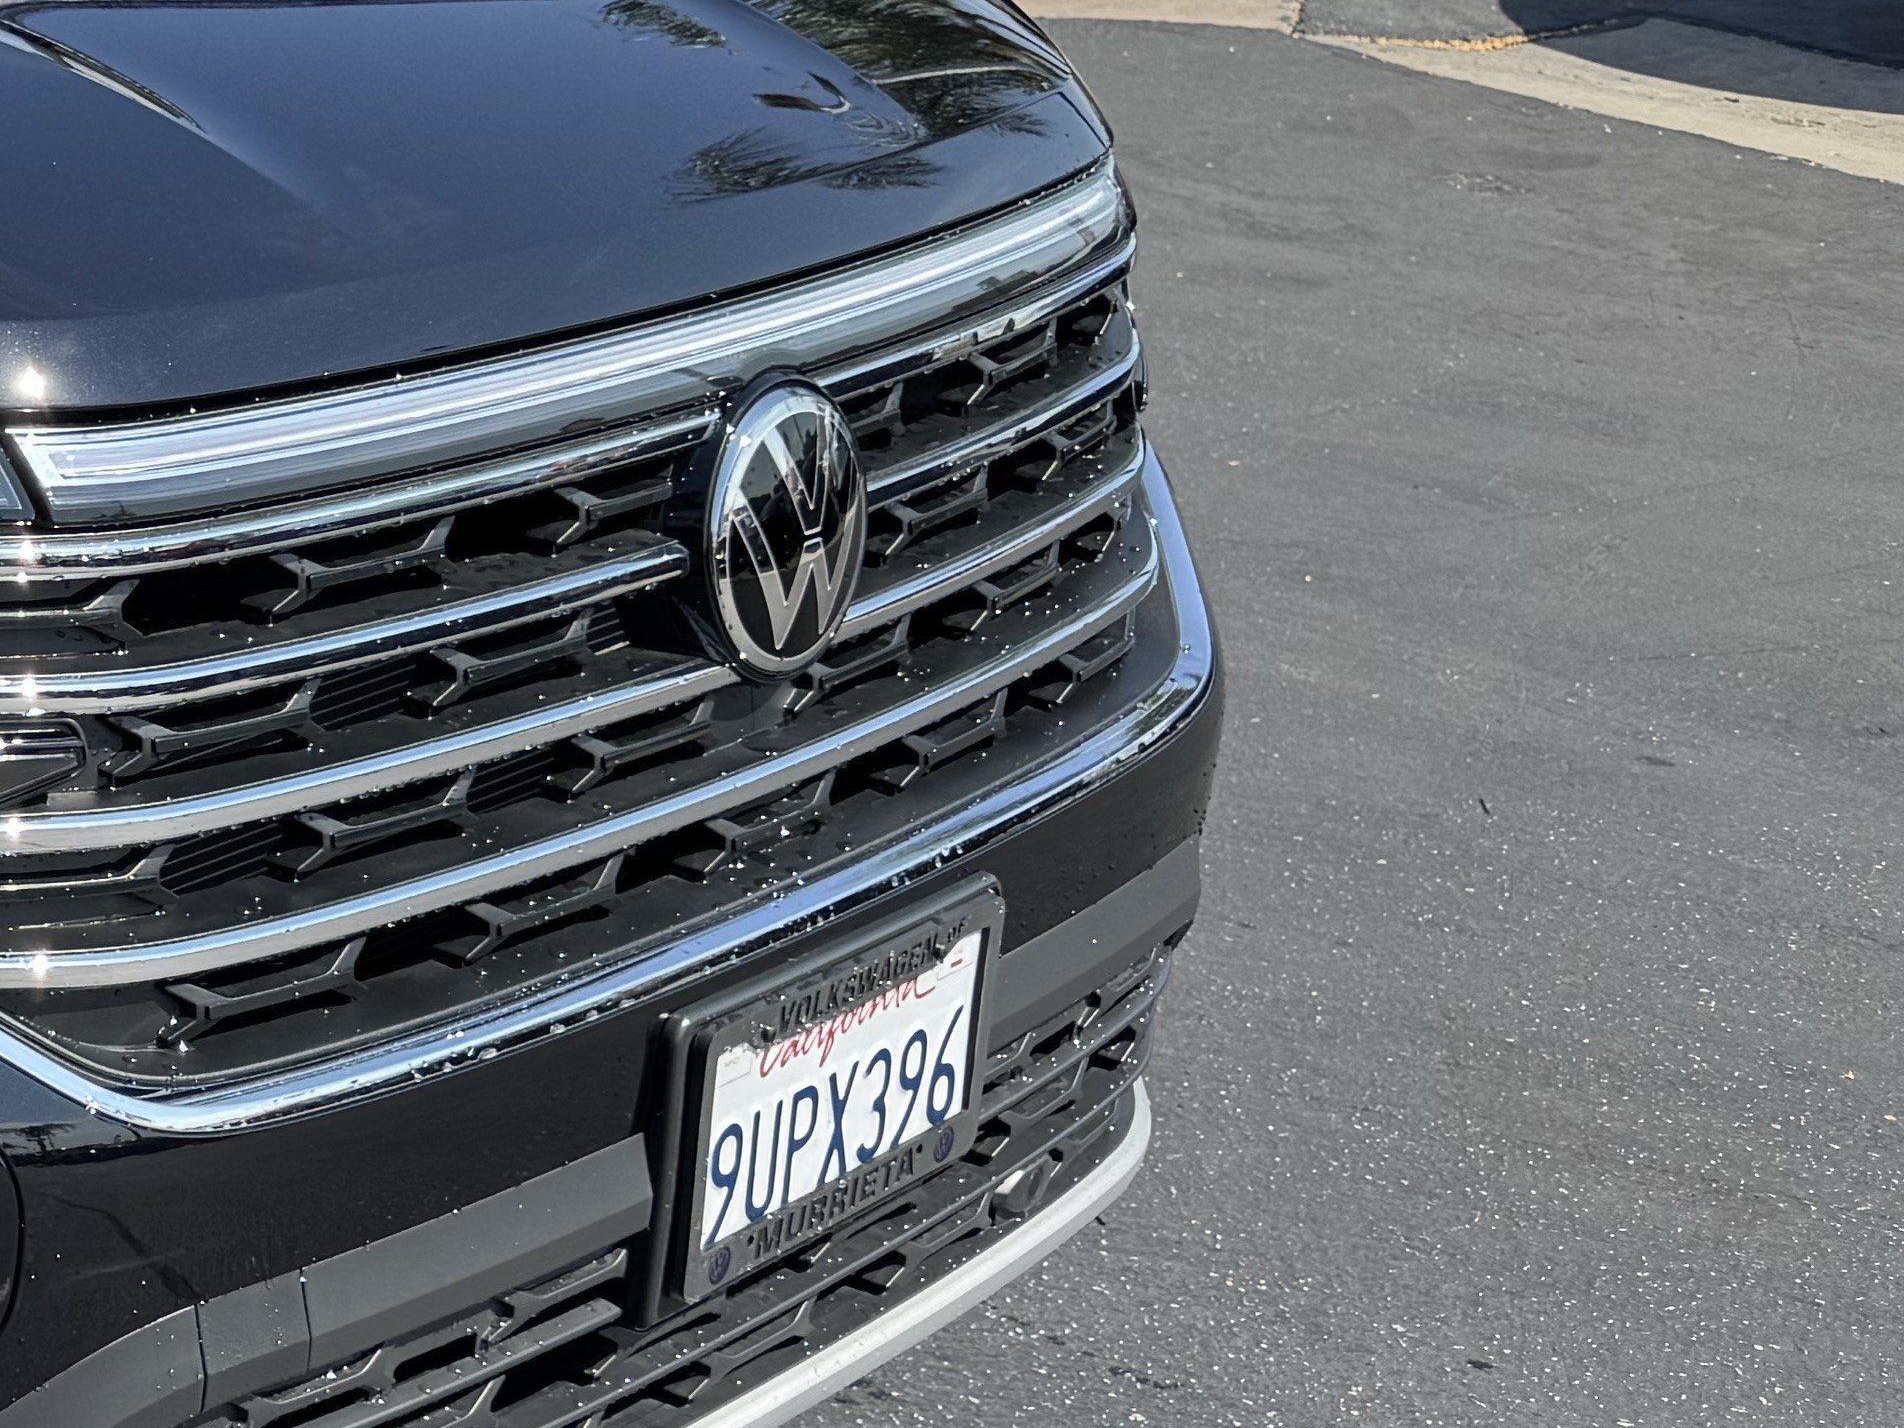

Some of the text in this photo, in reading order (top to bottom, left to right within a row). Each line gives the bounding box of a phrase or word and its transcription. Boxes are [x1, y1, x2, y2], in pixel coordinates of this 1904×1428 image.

[758, 975, 937, 1078] California
[703, 1004, 964, 1251] 9UPX396
[752, 1153, 916, 1260] MURRIETA
